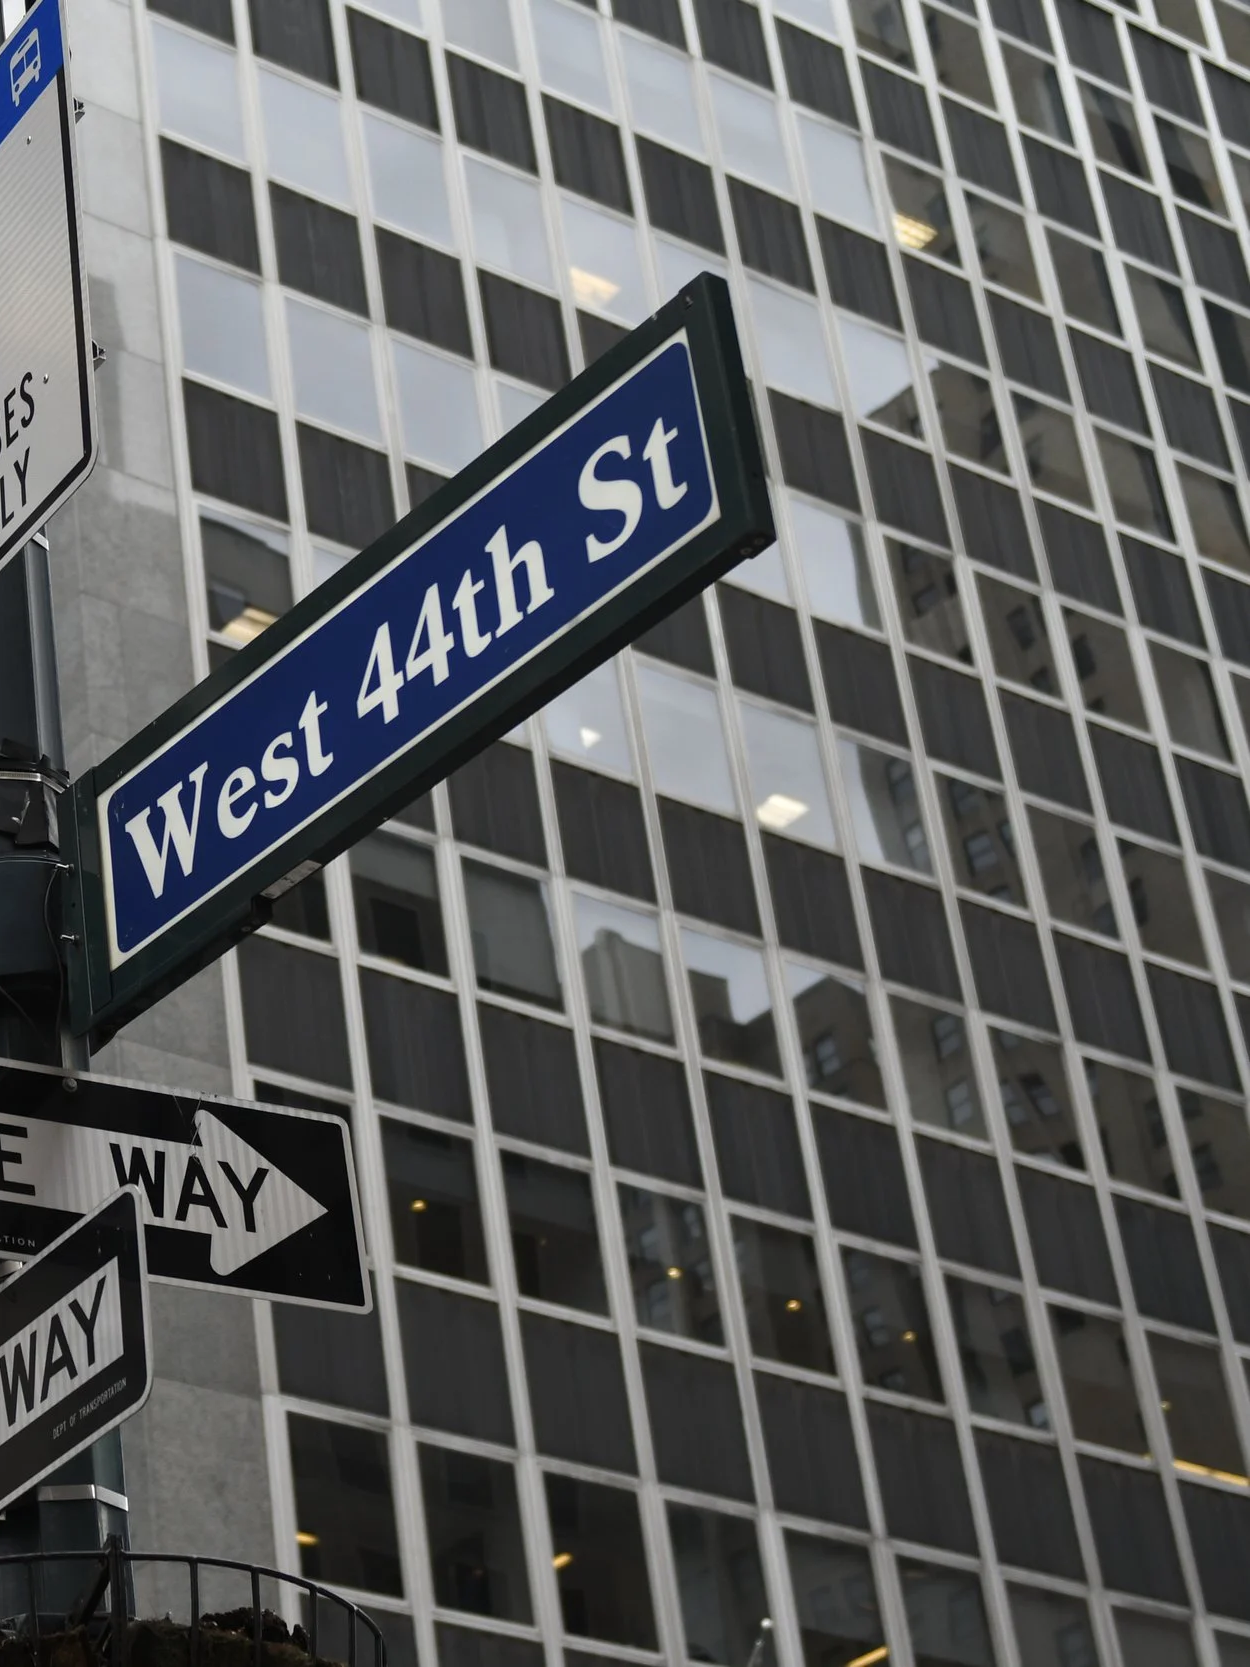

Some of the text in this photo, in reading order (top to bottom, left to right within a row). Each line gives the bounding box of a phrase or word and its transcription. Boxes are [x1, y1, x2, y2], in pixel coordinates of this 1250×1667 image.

[125, 417, 688, 898] West 44th St
[110, 1143, 269, 1234] WAY
[52, 1377, 127, 1439] DEPT OF TRANSPORTATION
